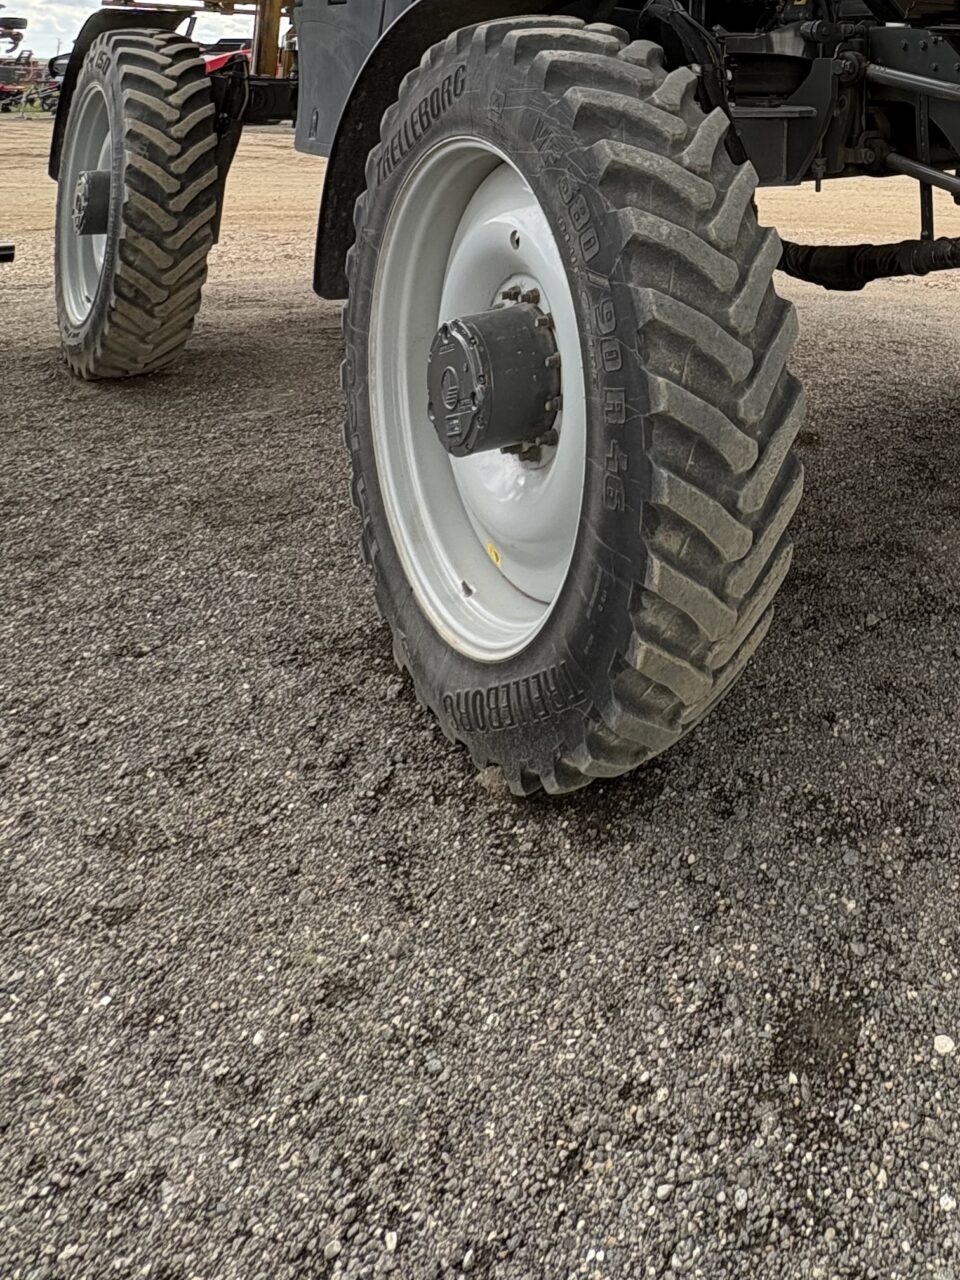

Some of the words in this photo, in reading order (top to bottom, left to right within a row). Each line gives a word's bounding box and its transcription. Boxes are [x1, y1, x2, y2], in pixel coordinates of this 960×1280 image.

[376, 63, 467, 187] TRELLEBORG
[603, 439, 629, 513] 46
[443, 660, 587, 733] TRELLEBORG
